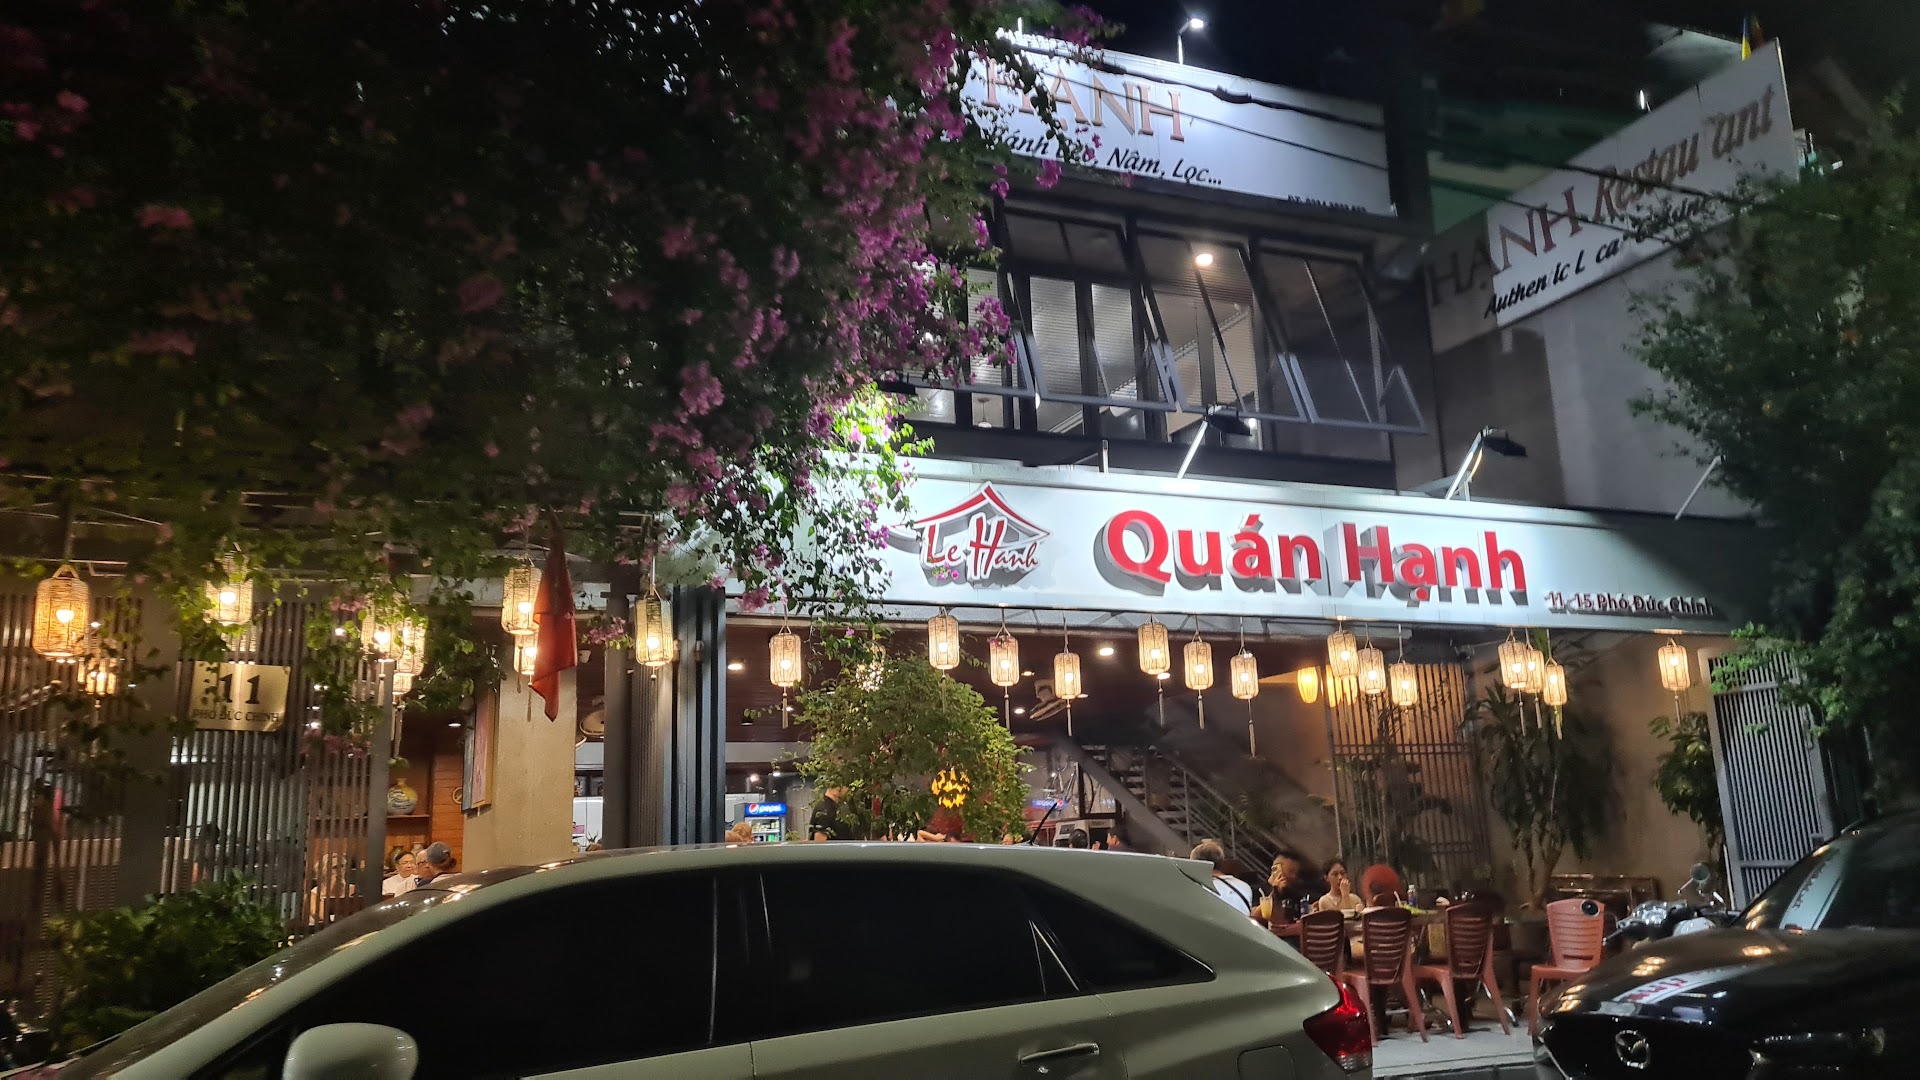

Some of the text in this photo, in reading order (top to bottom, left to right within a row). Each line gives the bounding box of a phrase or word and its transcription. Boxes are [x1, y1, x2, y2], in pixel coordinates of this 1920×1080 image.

[1004, 128, 1050, 156] ánh
[1593, 83, 1774, 224] Restauant
[1484, 261, 1571, 319] Authenic
[1575, 228, 1627, 275] Lca
[1106, 509, 1527, 601] Quán Hạnh
[219, 673, 261, 705] 11
